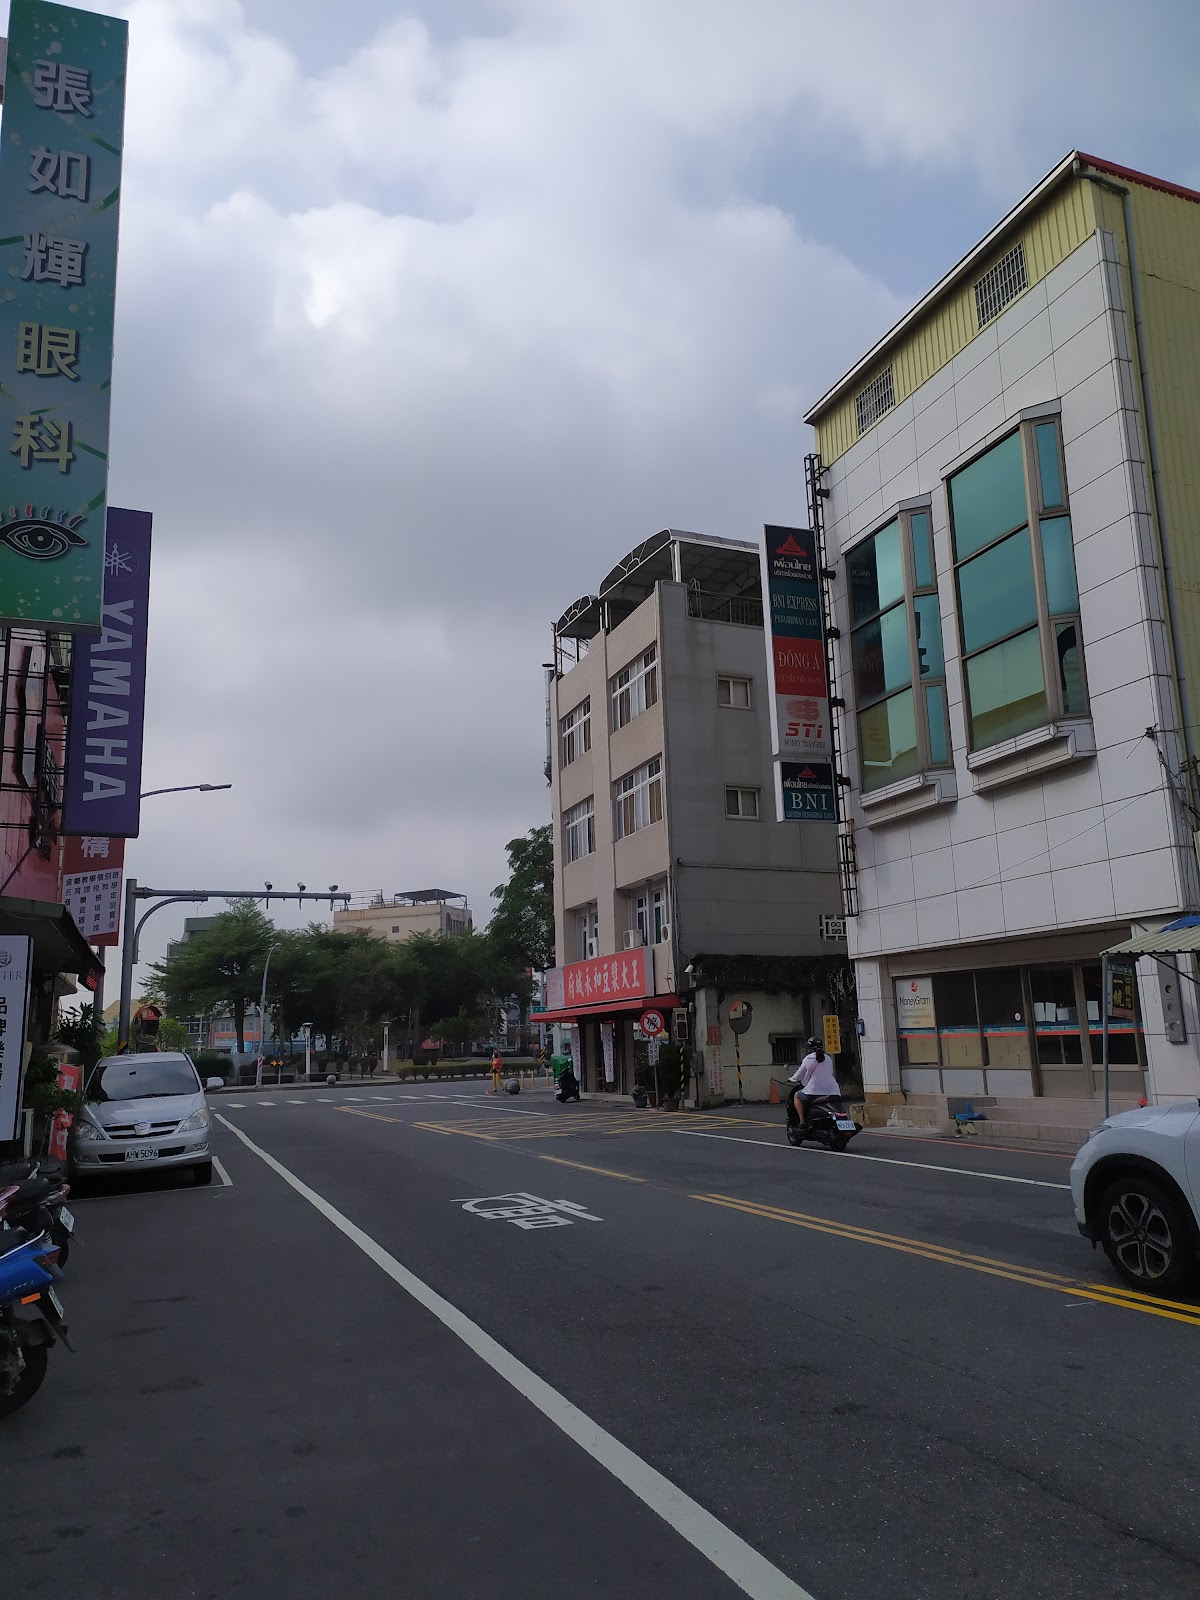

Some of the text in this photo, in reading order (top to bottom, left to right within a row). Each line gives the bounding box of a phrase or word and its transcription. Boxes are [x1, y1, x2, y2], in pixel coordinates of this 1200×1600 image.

[10, 59, 93, 472] 張如輝眼科
[772, 593, 818, 611] BNI EXPRESS
[83, 599, 134, 802] YAMAHA
[790, 792, 828, 810] BNI
[899, 995, 931, 1007] MoneyGram
